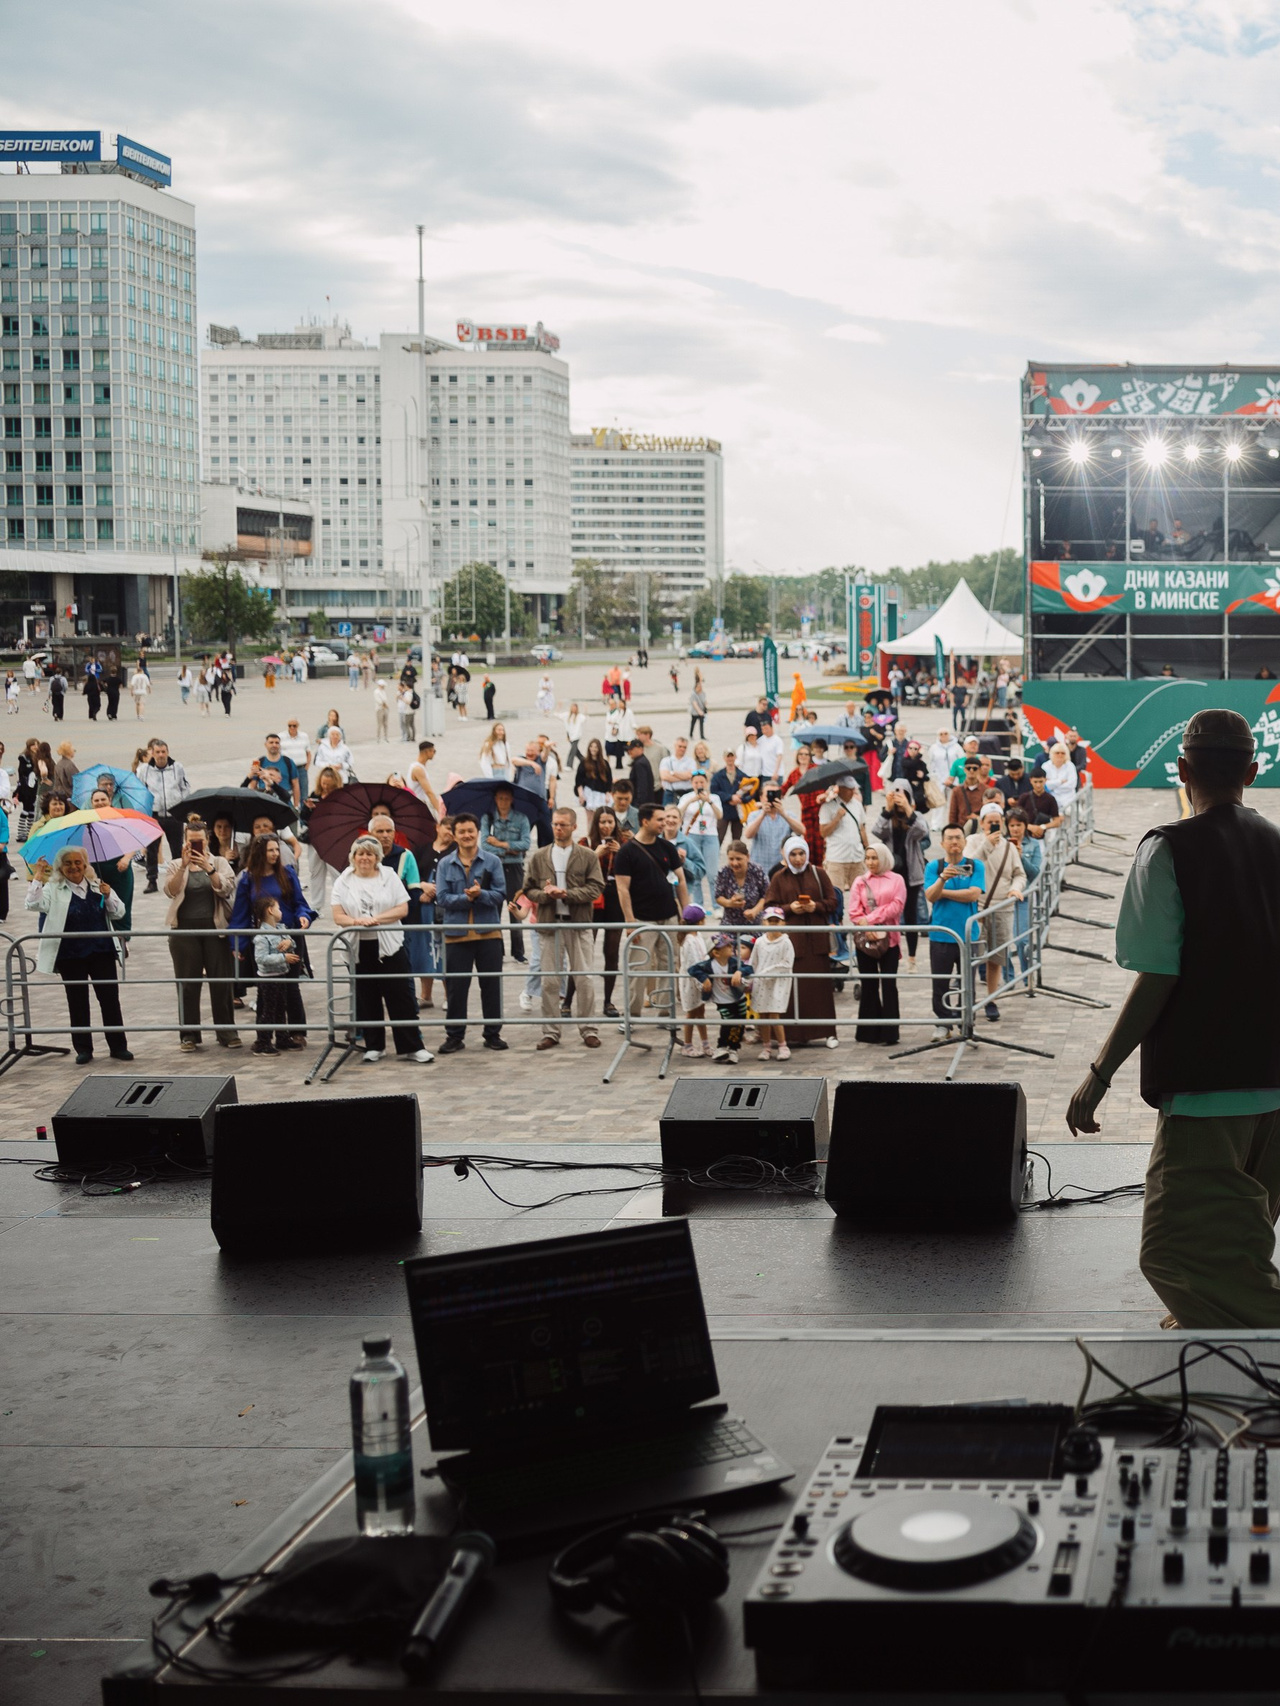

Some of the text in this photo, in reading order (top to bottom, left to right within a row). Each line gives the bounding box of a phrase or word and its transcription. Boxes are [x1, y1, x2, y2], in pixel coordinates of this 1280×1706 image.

[477, 327, 527, 341] BSB
[1123, 569, 1230, 591] ДНИ КАЗАНИ
[1134, 591, 1220, 610] В МИНСКЕ
